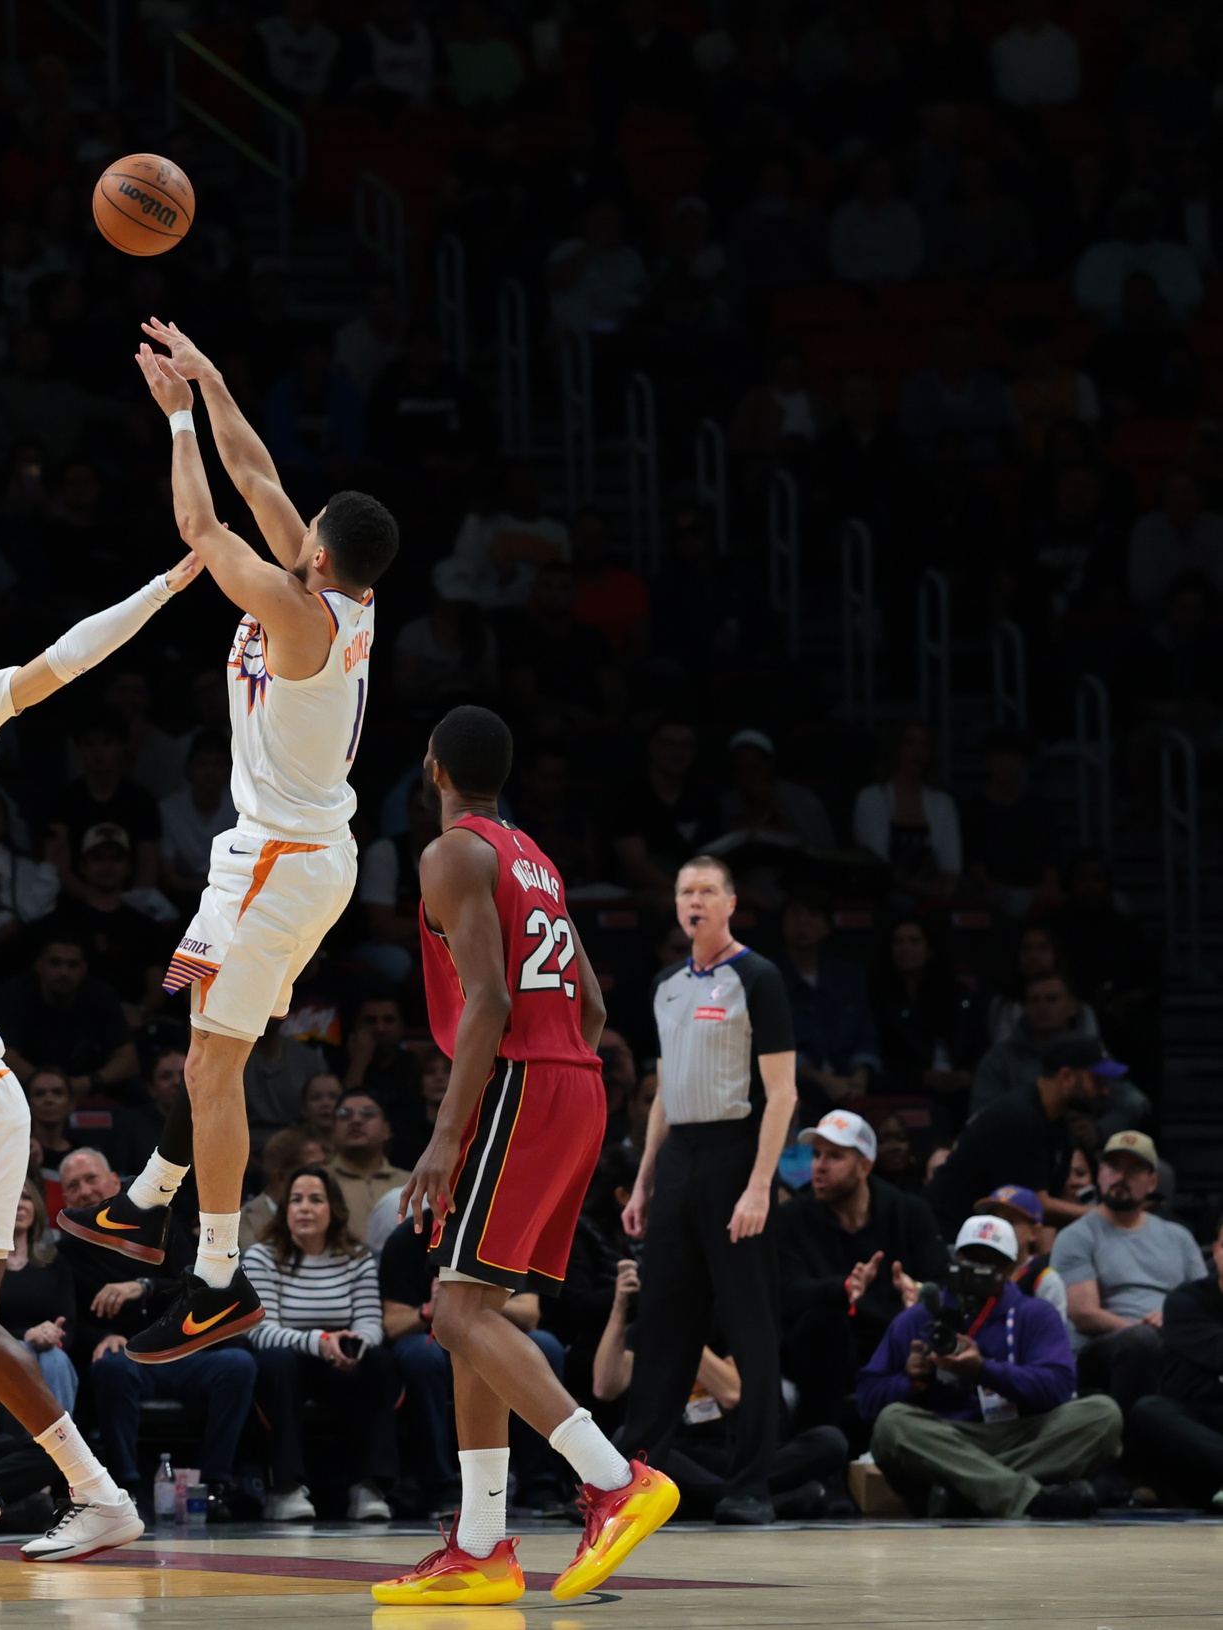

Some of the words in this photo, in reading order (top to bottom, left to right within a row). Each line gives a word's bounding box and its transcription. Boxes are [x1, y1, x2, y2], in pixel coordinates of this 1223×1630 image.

[118, 182, 177, 229] Wilson
[343, 630, 370, 675] BOOKE
[345, 677, 365, 763] 1
[179, 937, 213, 956] OENIX
[517, 907, 576, 1000] 22
